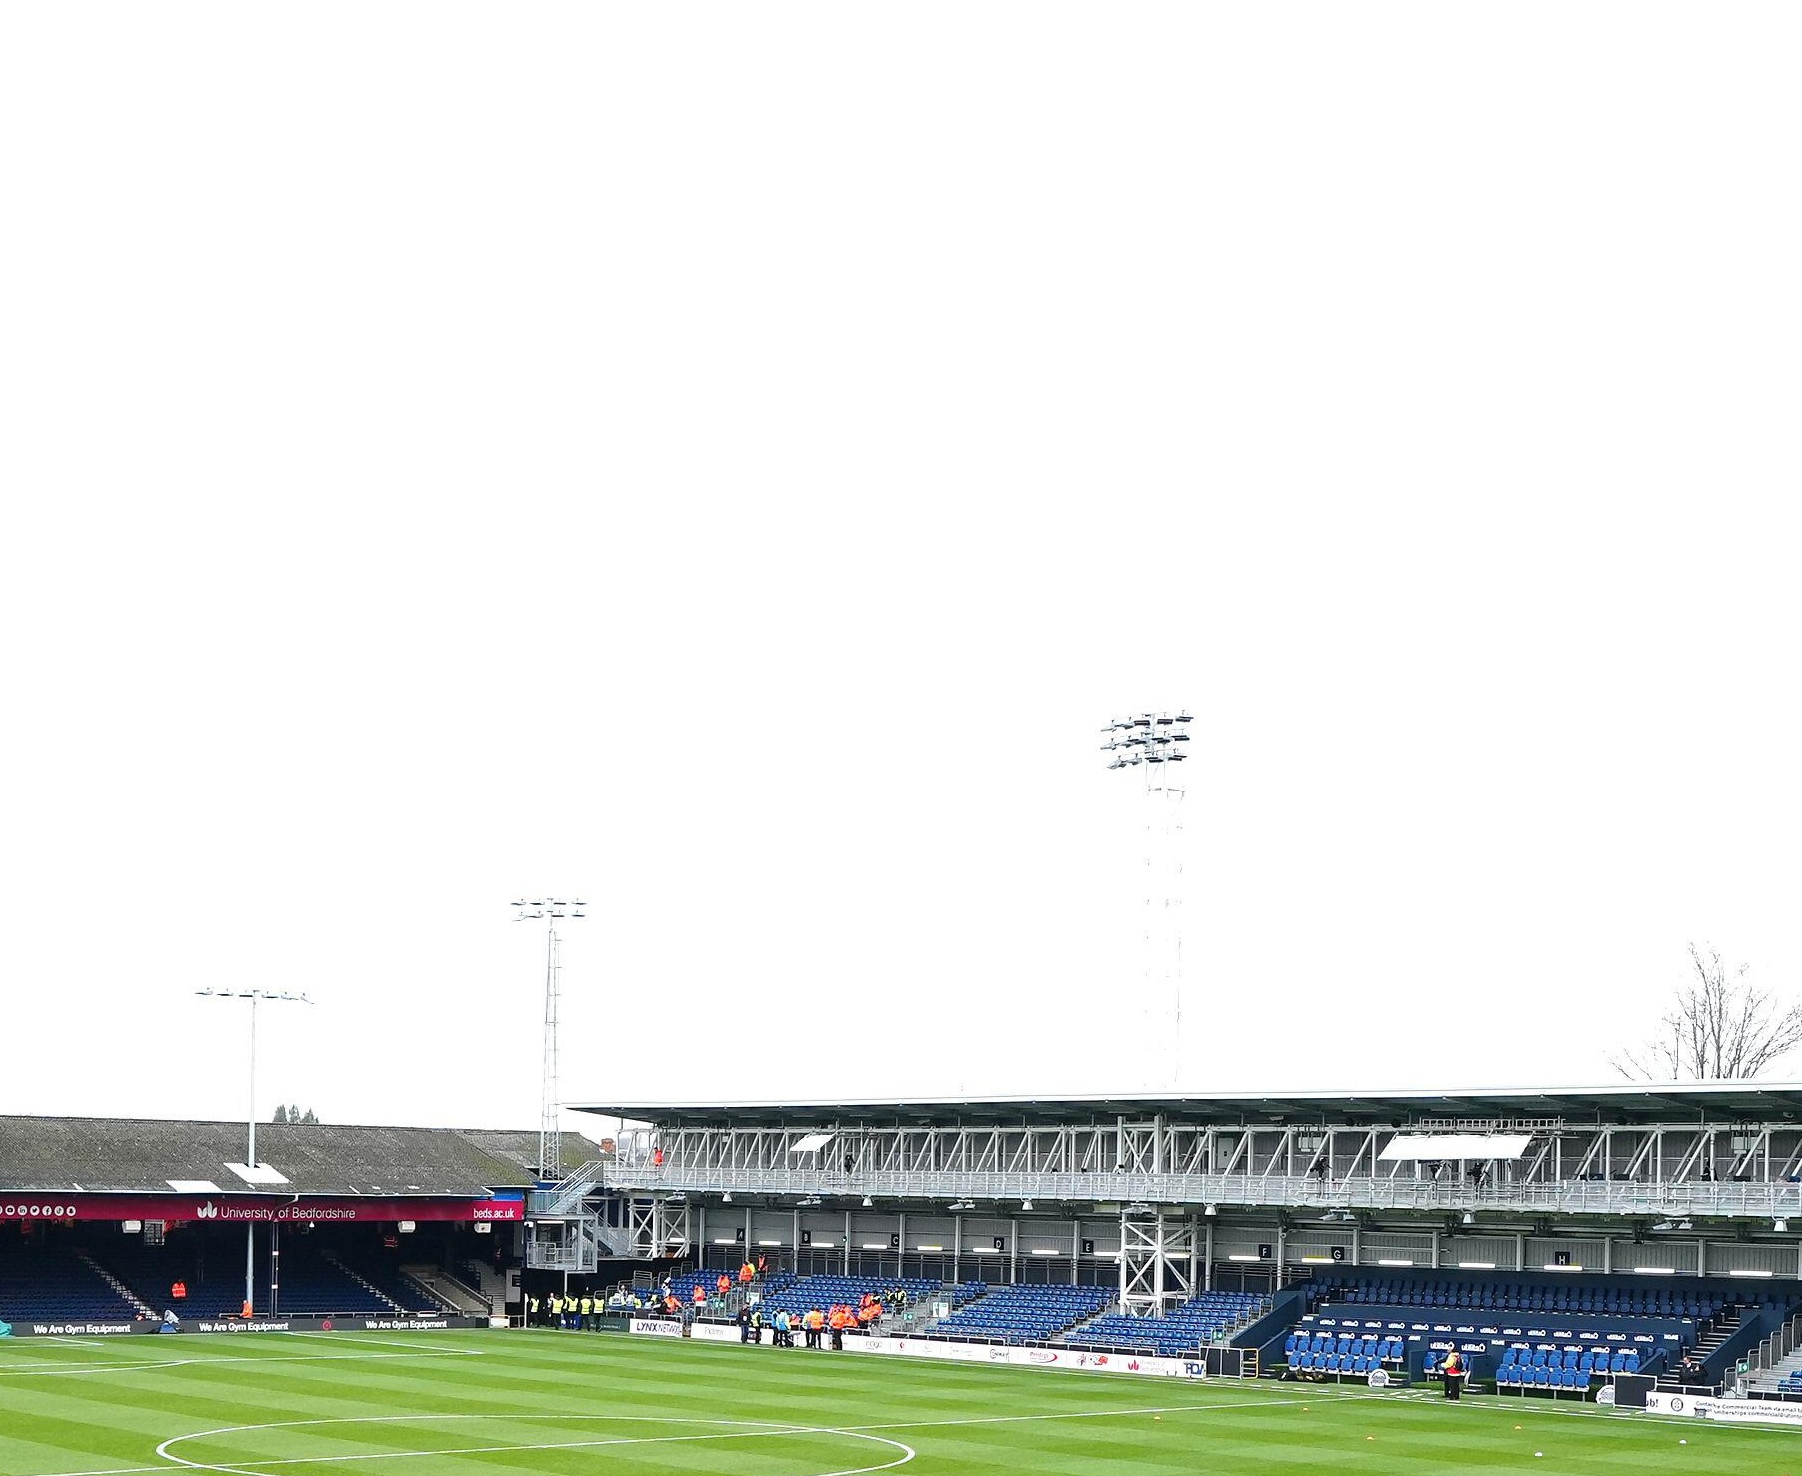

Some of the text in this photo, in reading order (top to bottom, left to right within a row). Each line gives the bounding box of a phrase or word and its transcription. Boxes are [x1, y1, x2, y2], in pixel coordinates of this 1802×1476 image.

[221, 1207, 356, 1221] University of Bedfordshire
[474, 1208, 515, 1219] beds.ac.uk
[1333, 1250, 1342, 1260] G
[1559, 1256, 1566, 1265] H
[34, 1324, 131, 1335] We Are Gym Equipment
[199, 1322, 289, 1332] We Are Gym Equipment
